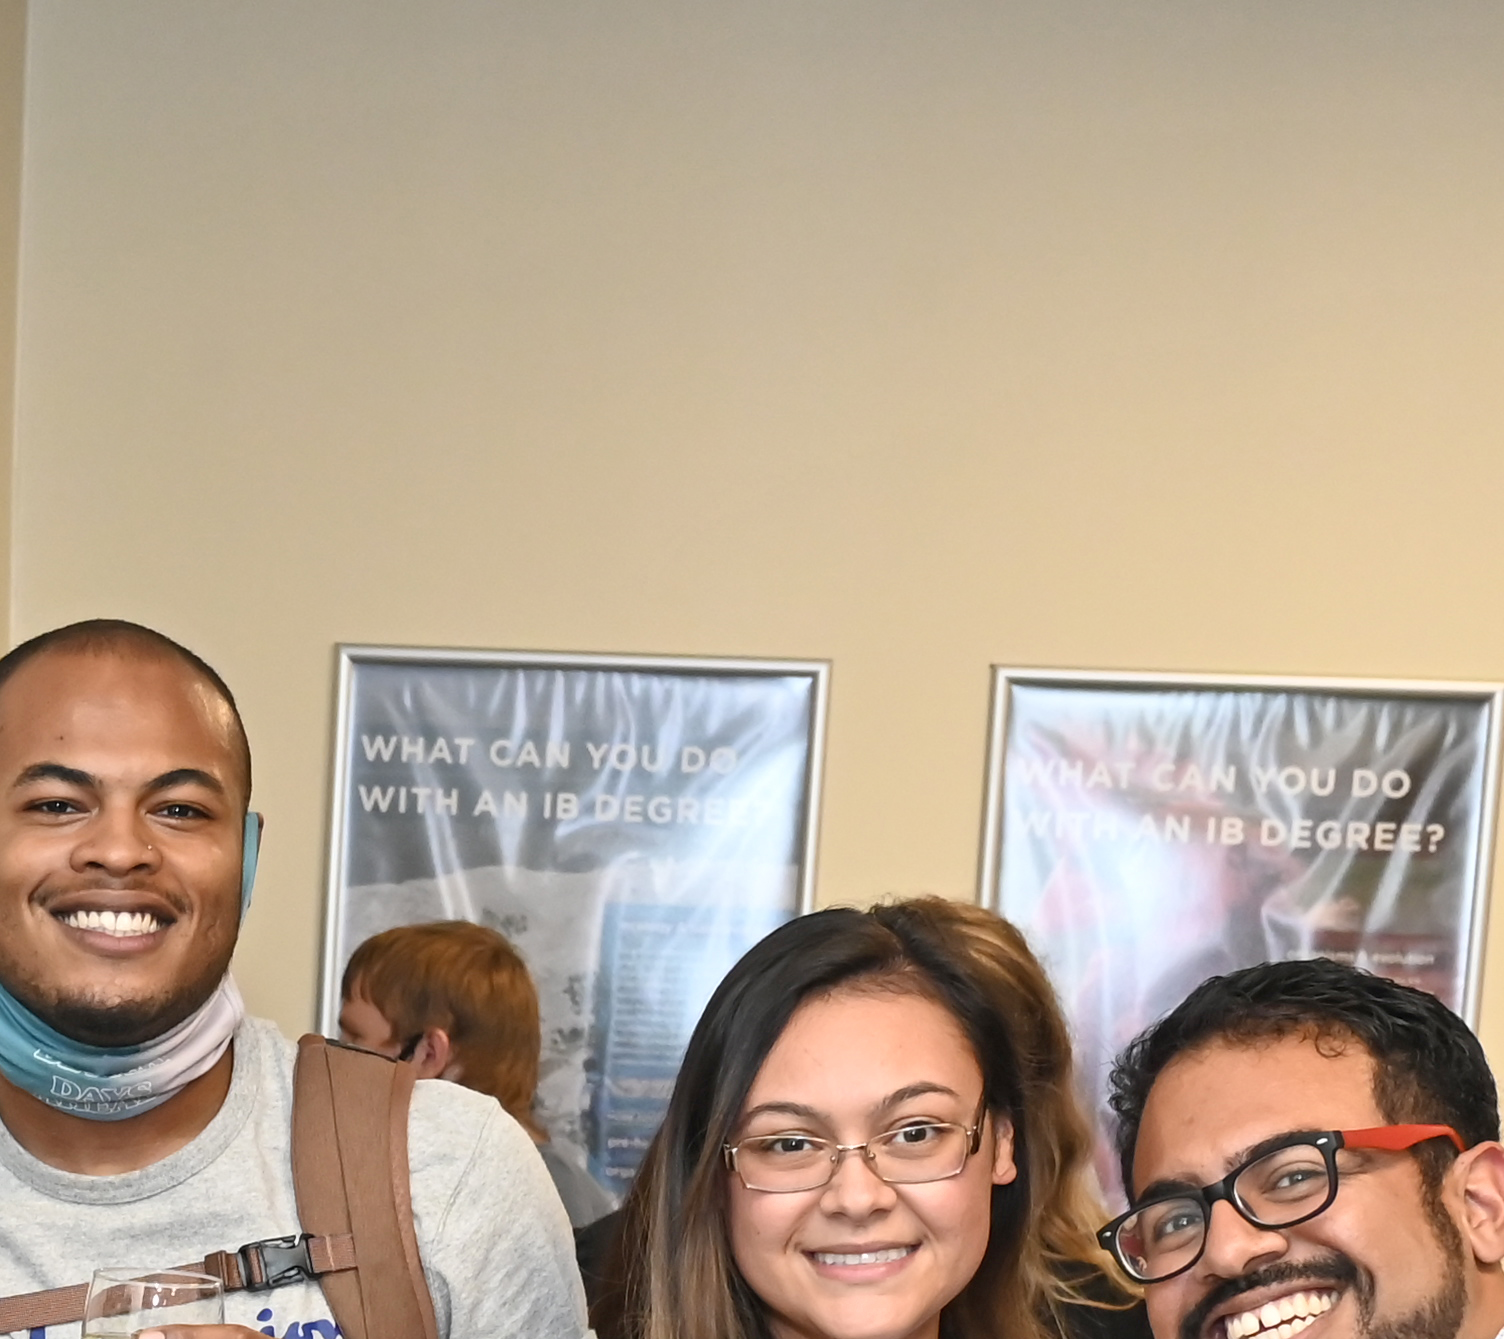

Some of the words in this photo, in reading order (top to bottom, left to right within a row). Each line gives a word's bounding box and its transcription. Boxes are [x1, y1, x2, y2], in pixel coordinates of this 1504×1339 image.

[362, 735, 474, 766] WHAT
[490, 739, 570, 769] CAN
[586, 743, 665, 772] YOU
[680, 747, 739, 775] DO
[1018, 756, 1133, 790] WHAT
[1153, 762, 1238, 794] CAN
[1252, 767, 1337, 797] YOU
[1352, 769, 1412, 800] DO
[358, 784, 459, 816] WITH
[473, 788, 528, 818] AN
[543, 792, 579, 822] IB
[1015, 808, 1120, 842] WITH
[1137, 815, 1191, 845] AN
[1207, 817, 1244, 848] IB
[1260, 819, 1445, 854] DEGREE?
